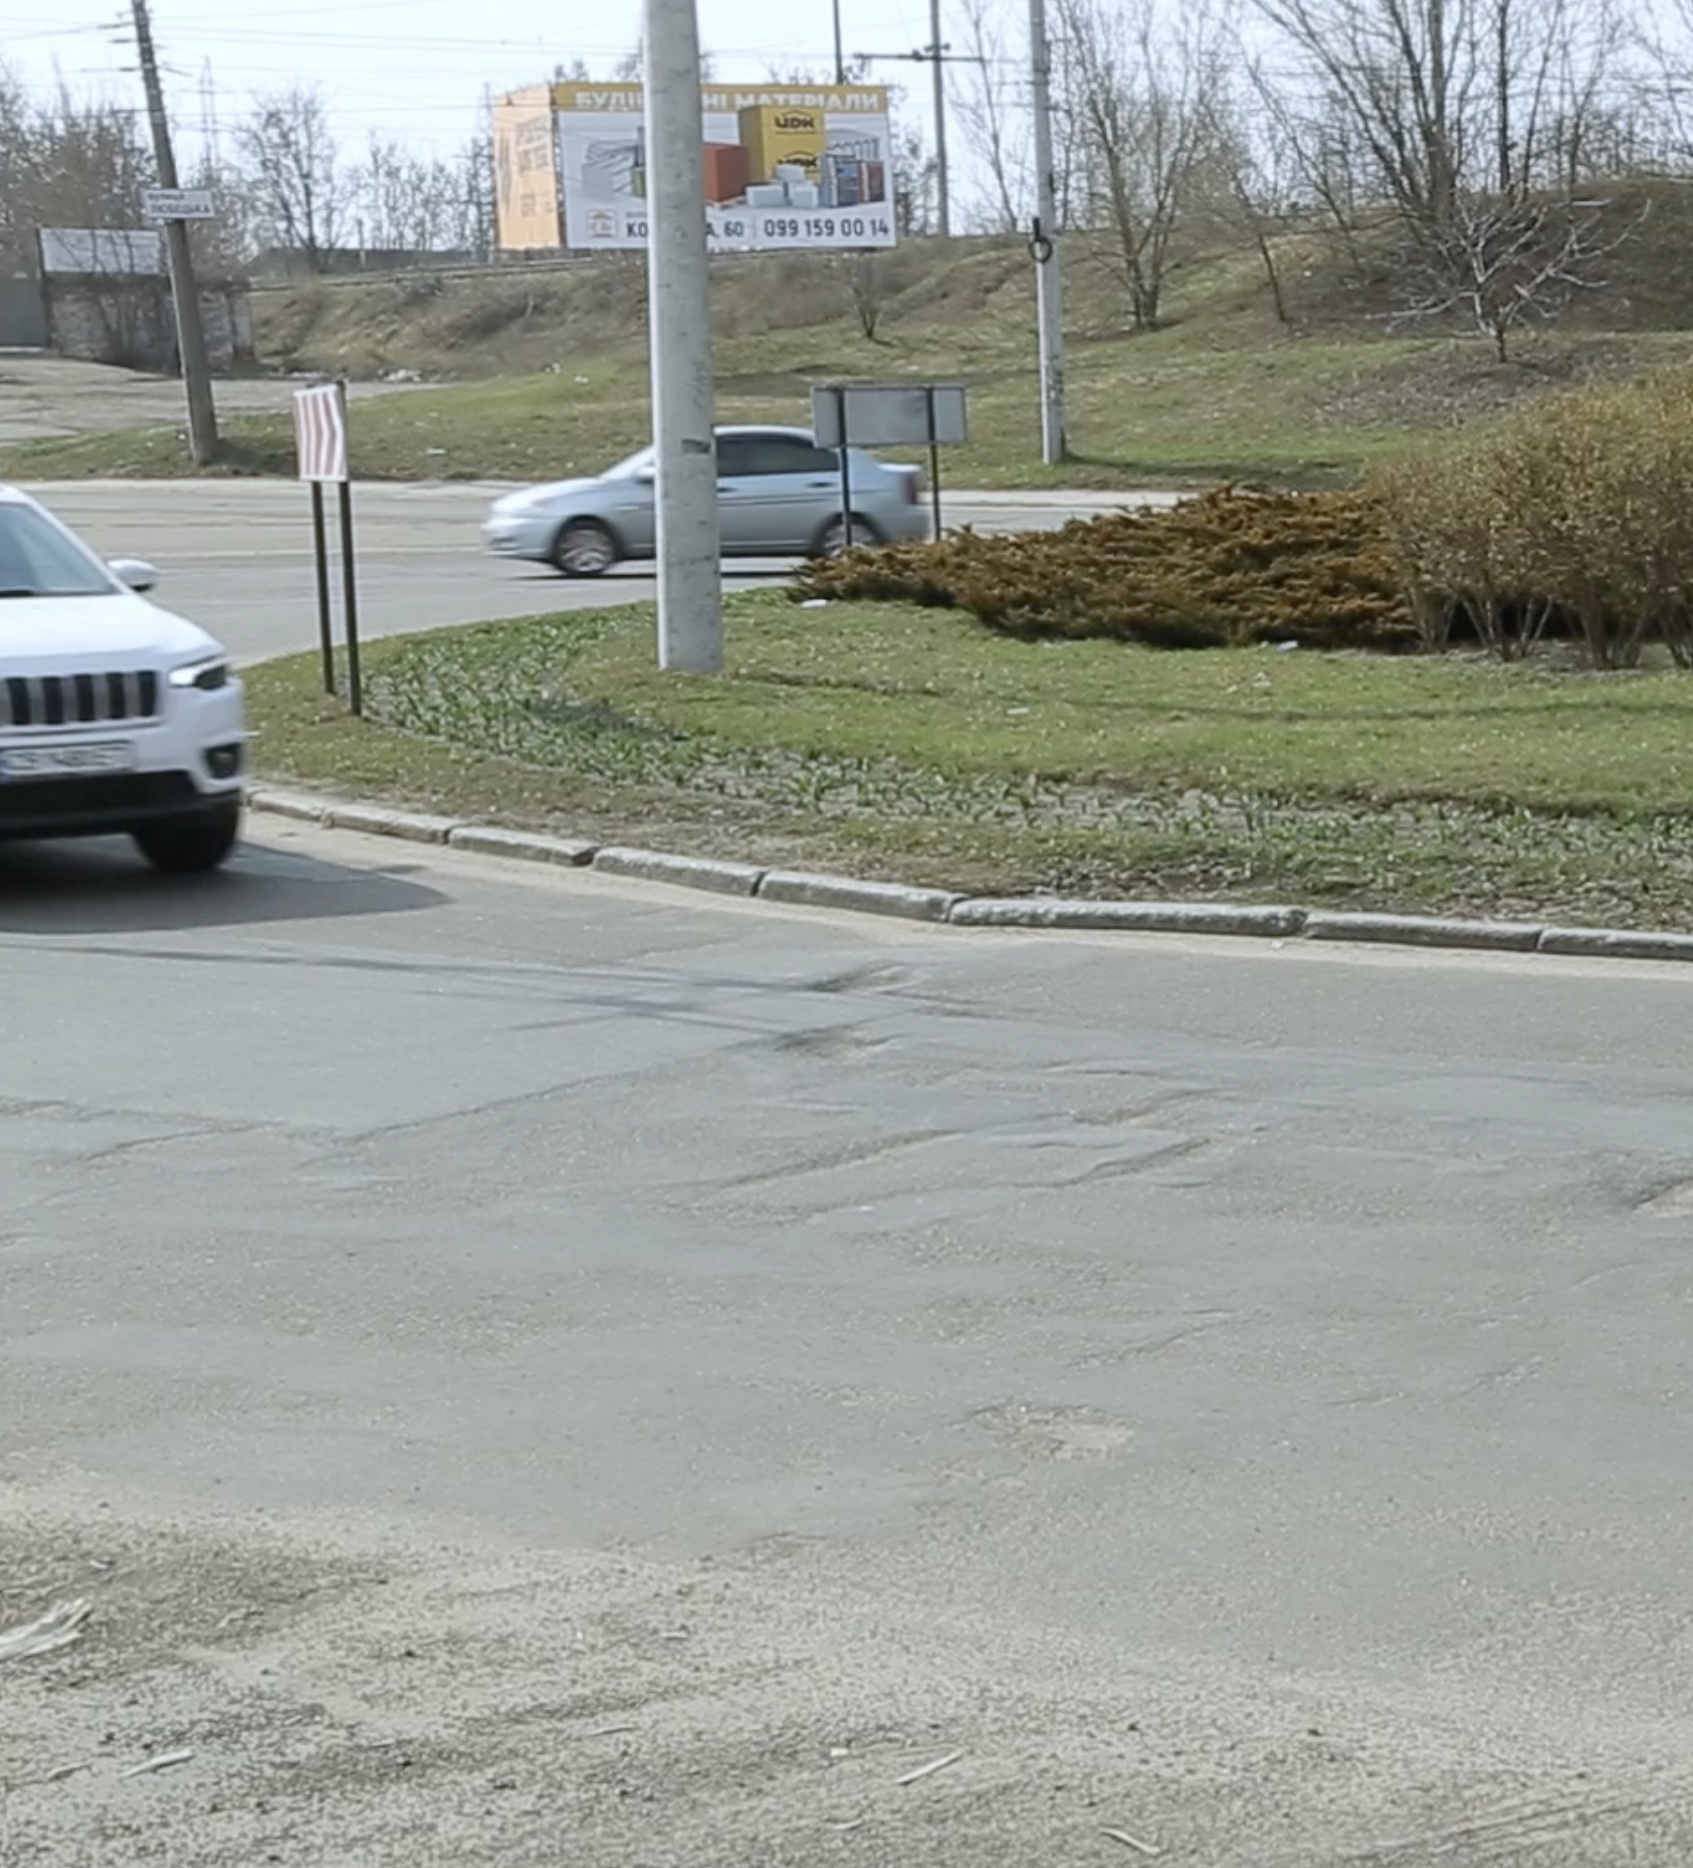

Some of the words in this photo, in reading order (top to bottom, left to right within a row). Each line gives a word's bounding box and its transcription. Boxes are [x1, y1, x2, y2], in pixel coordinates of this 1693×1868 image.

[724, 220, 744, 238] 60
[764, 219, 799, 238] 099
[804, 219, 835, 237] 159
[841, 218, 864, 237] 00
[870, 218, 889, 236] 14
